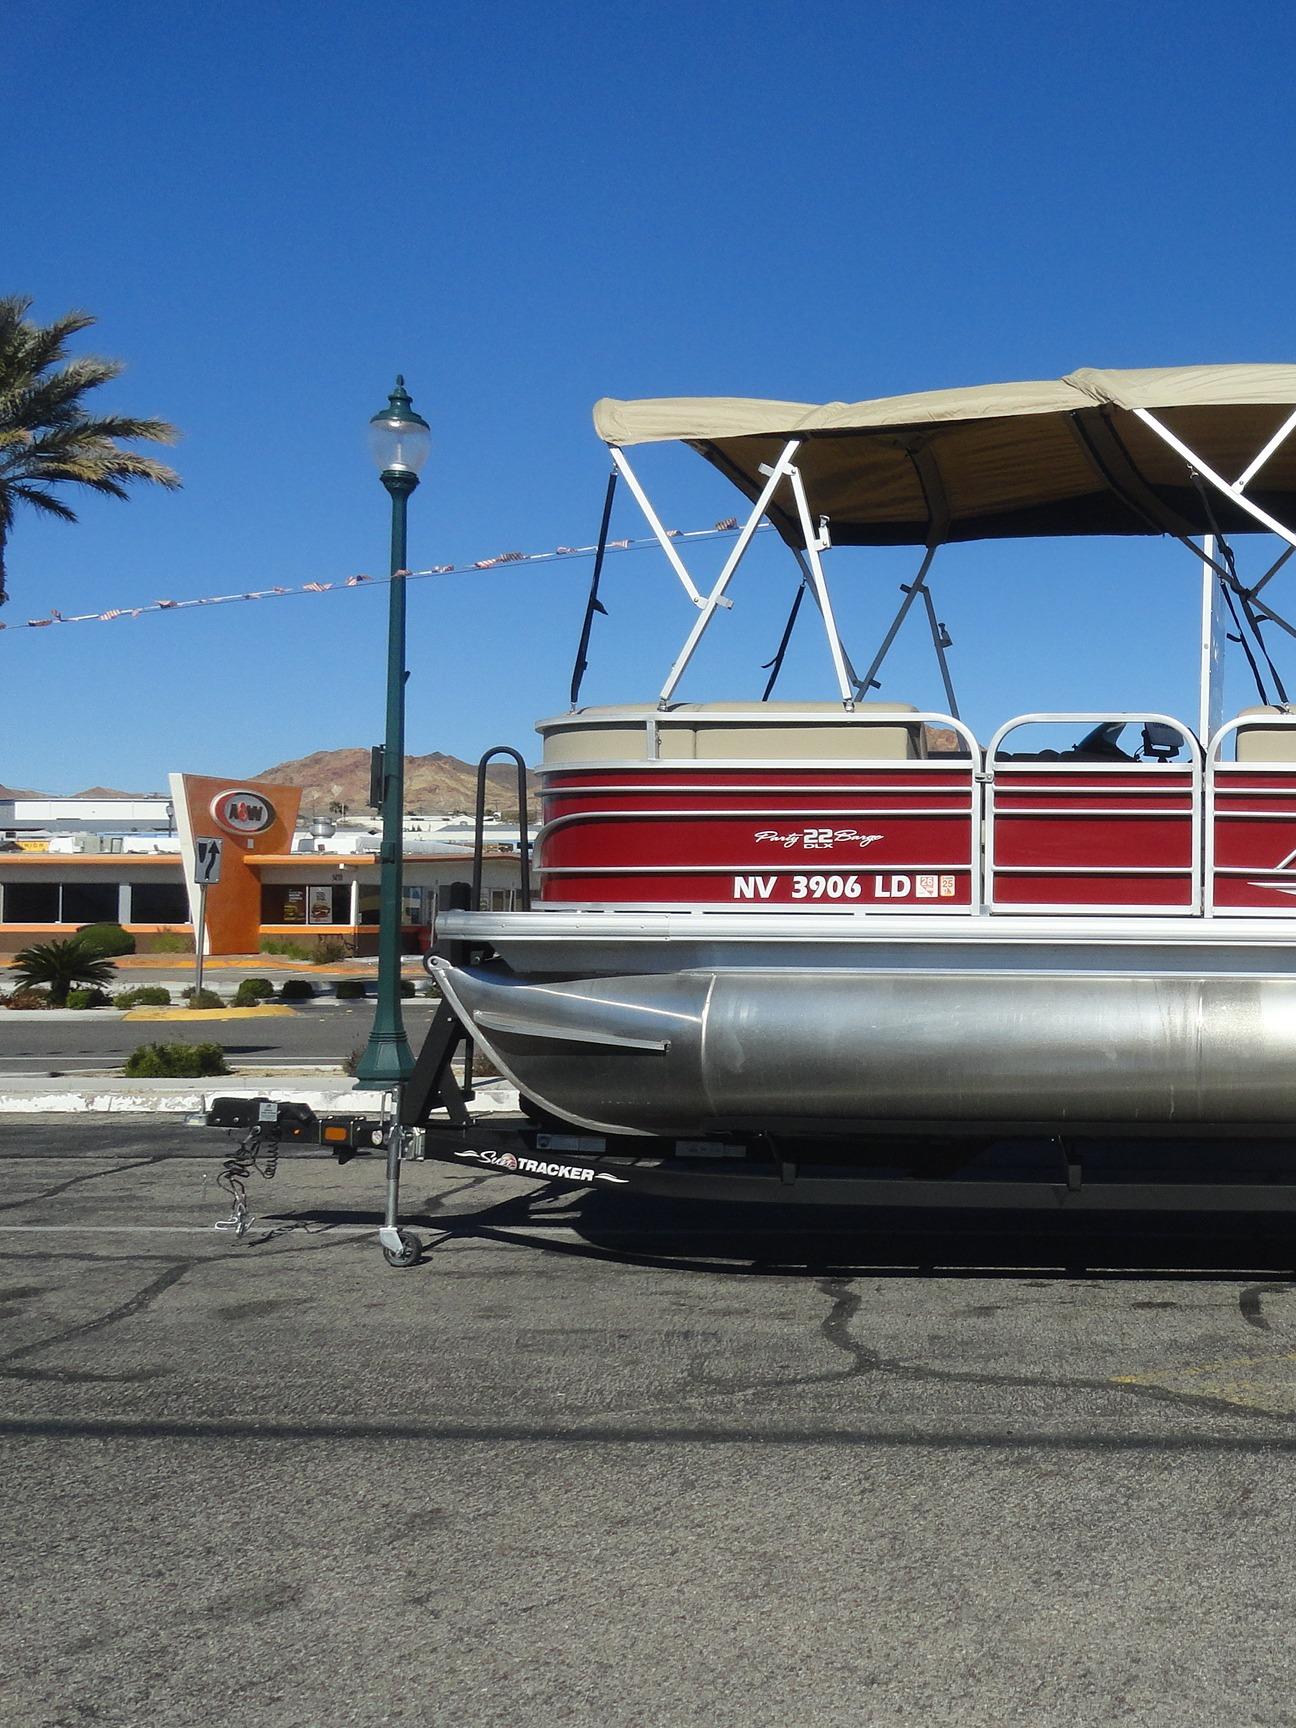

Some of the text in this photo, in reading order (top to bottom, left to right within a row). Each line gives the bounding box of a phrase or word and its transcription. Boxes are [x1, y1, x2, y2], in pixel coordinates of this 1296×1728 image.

[229, 802, 263, 822] A&W
[754, 828, 884, 848] Party 22 Barge
[733, 875, 911, 899] NV 3906 LD
[942, 879, 953, 888] 25
[478, 1150, 595, 1182] Sun TRACKER
